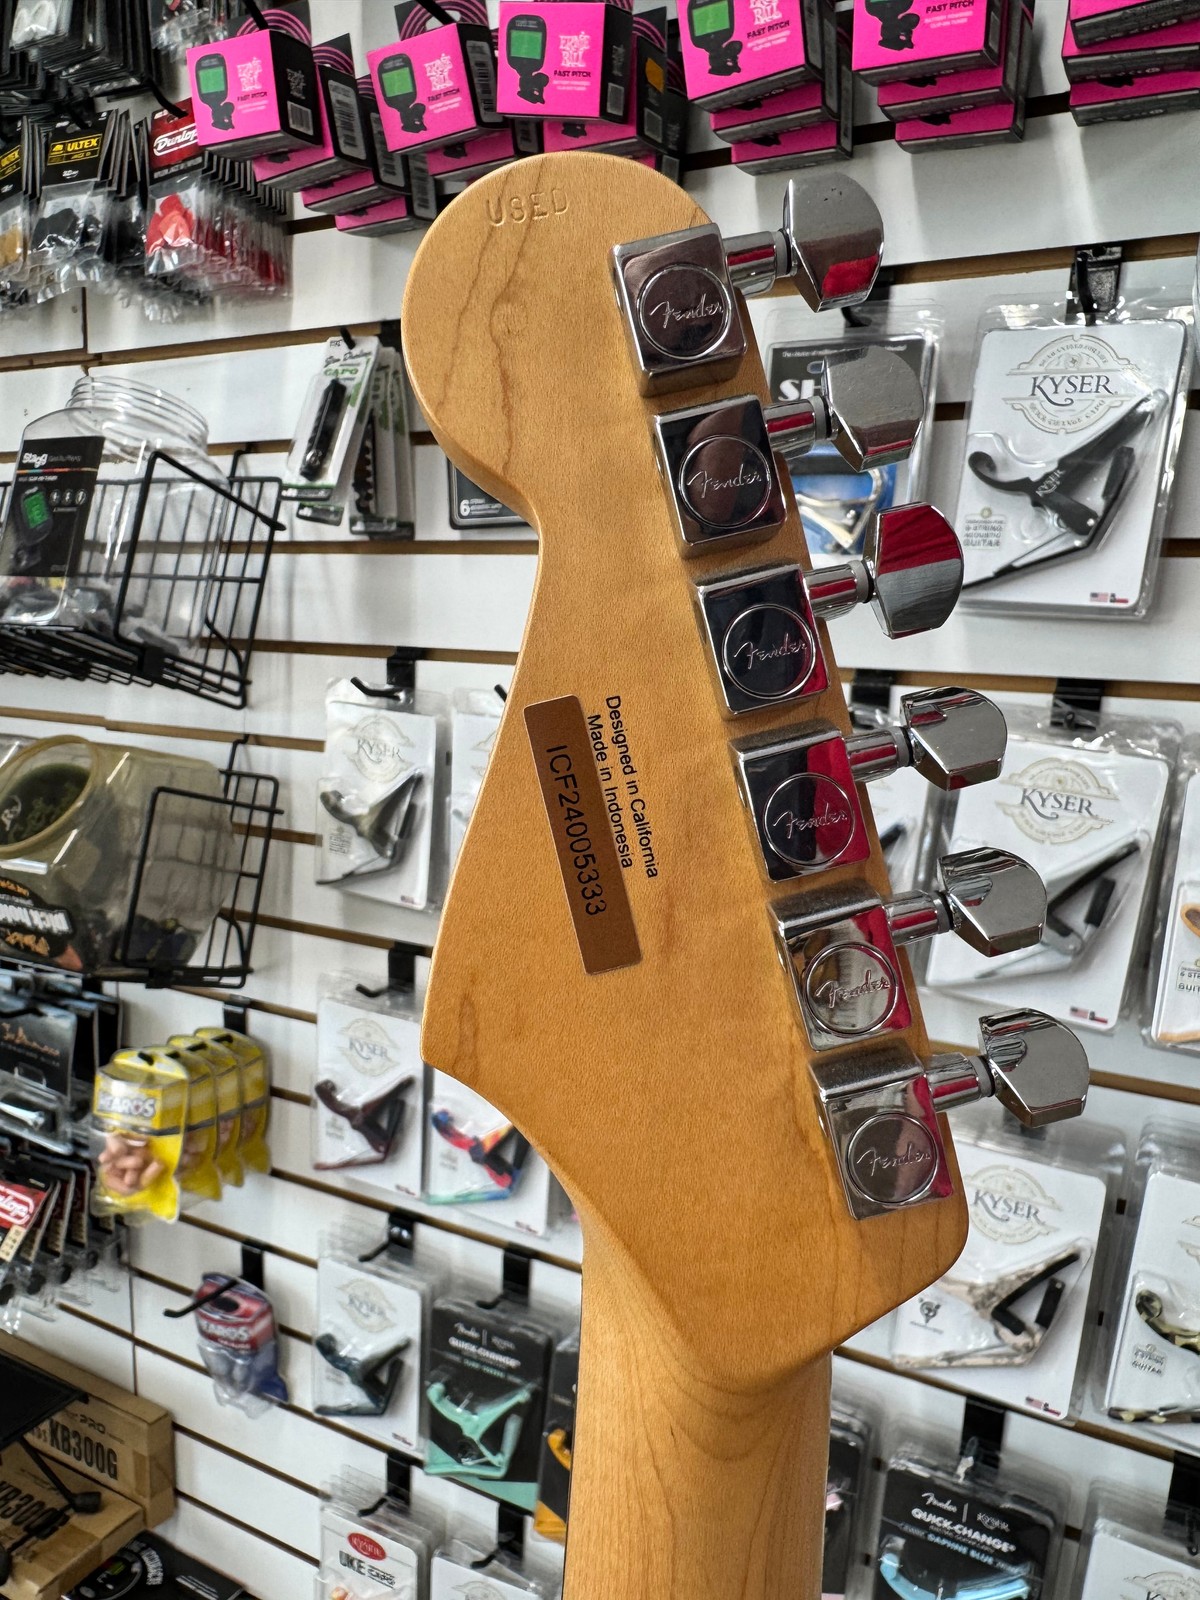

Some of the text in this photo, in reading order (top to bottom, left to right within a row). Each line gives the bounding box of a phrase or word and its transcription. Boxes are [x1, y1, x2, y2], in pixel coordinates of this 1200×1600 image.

[926, 0, 974, 13] FAST PITCH
[747, 20, 790, 38] FAST PITCH
[67, 137, 98, 152] ULTEX
[486, 187, 569, 227] USED
[649, 293, 724, 329] Fender
[1029, 374, 1114, 407] KYSER
[22, 453, 48, 468] Stagg
[687, 463, 762, 499] Fender
[460, 499, 470, 516] 6
[733, 632, 807, 670] Fender
[587, 714, 633, 869] Made in Indonesia
[606, 695, 658, 879] Designed in California
[773, 801, 848, 839] Fender
[1020, 788, 1097, 820] KYSER
[546, 744, 607, 917] ICF24005333
[815, 969, 891, 1009] Fender
[1178, 983, 1200, 992] GUIT
[856, 1142, 931, 1176] Fender
[974, 1189, 1045, 1225] KYSER
[921, 1492, 958, 1513] Fender
[339, 1550, 366, 1576] UKE
[969, 1549, 994, 1566] BLUE
